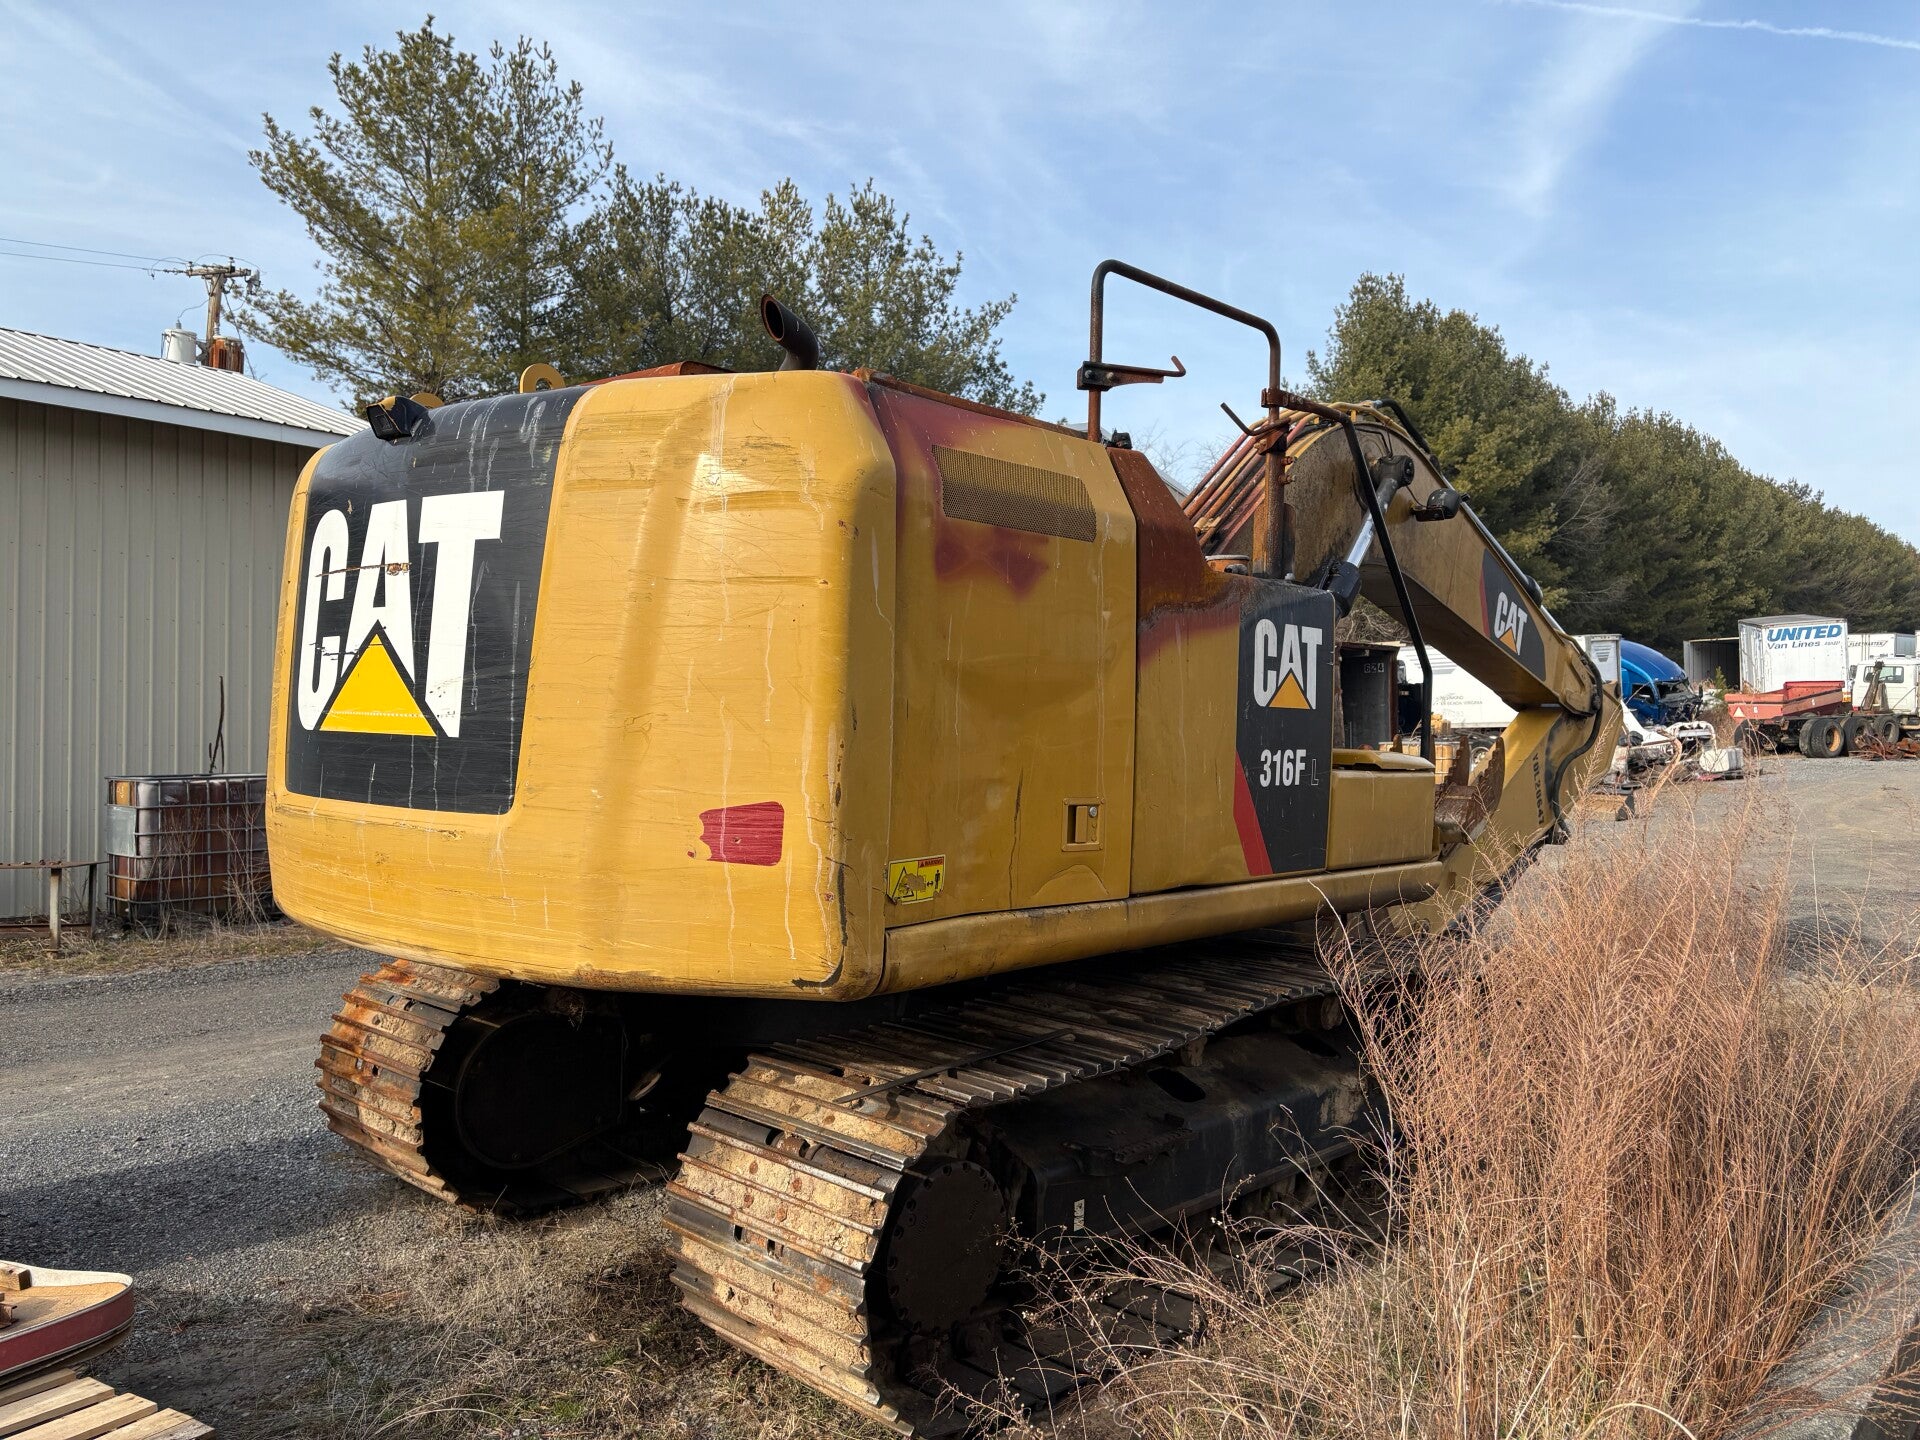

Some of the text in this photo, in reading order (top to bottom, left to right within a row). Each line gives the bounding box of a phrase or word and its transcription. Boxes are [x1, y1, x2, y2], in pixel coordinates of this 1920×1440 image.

[298, 490, 505, 738] CAT
[1494, 592, 1527, 655] CAT
[1767, 624, 1842, 641] UNITED
[1253, 618, 1323, 710] CAT
[1259, 749, 1307, 787] 316F
